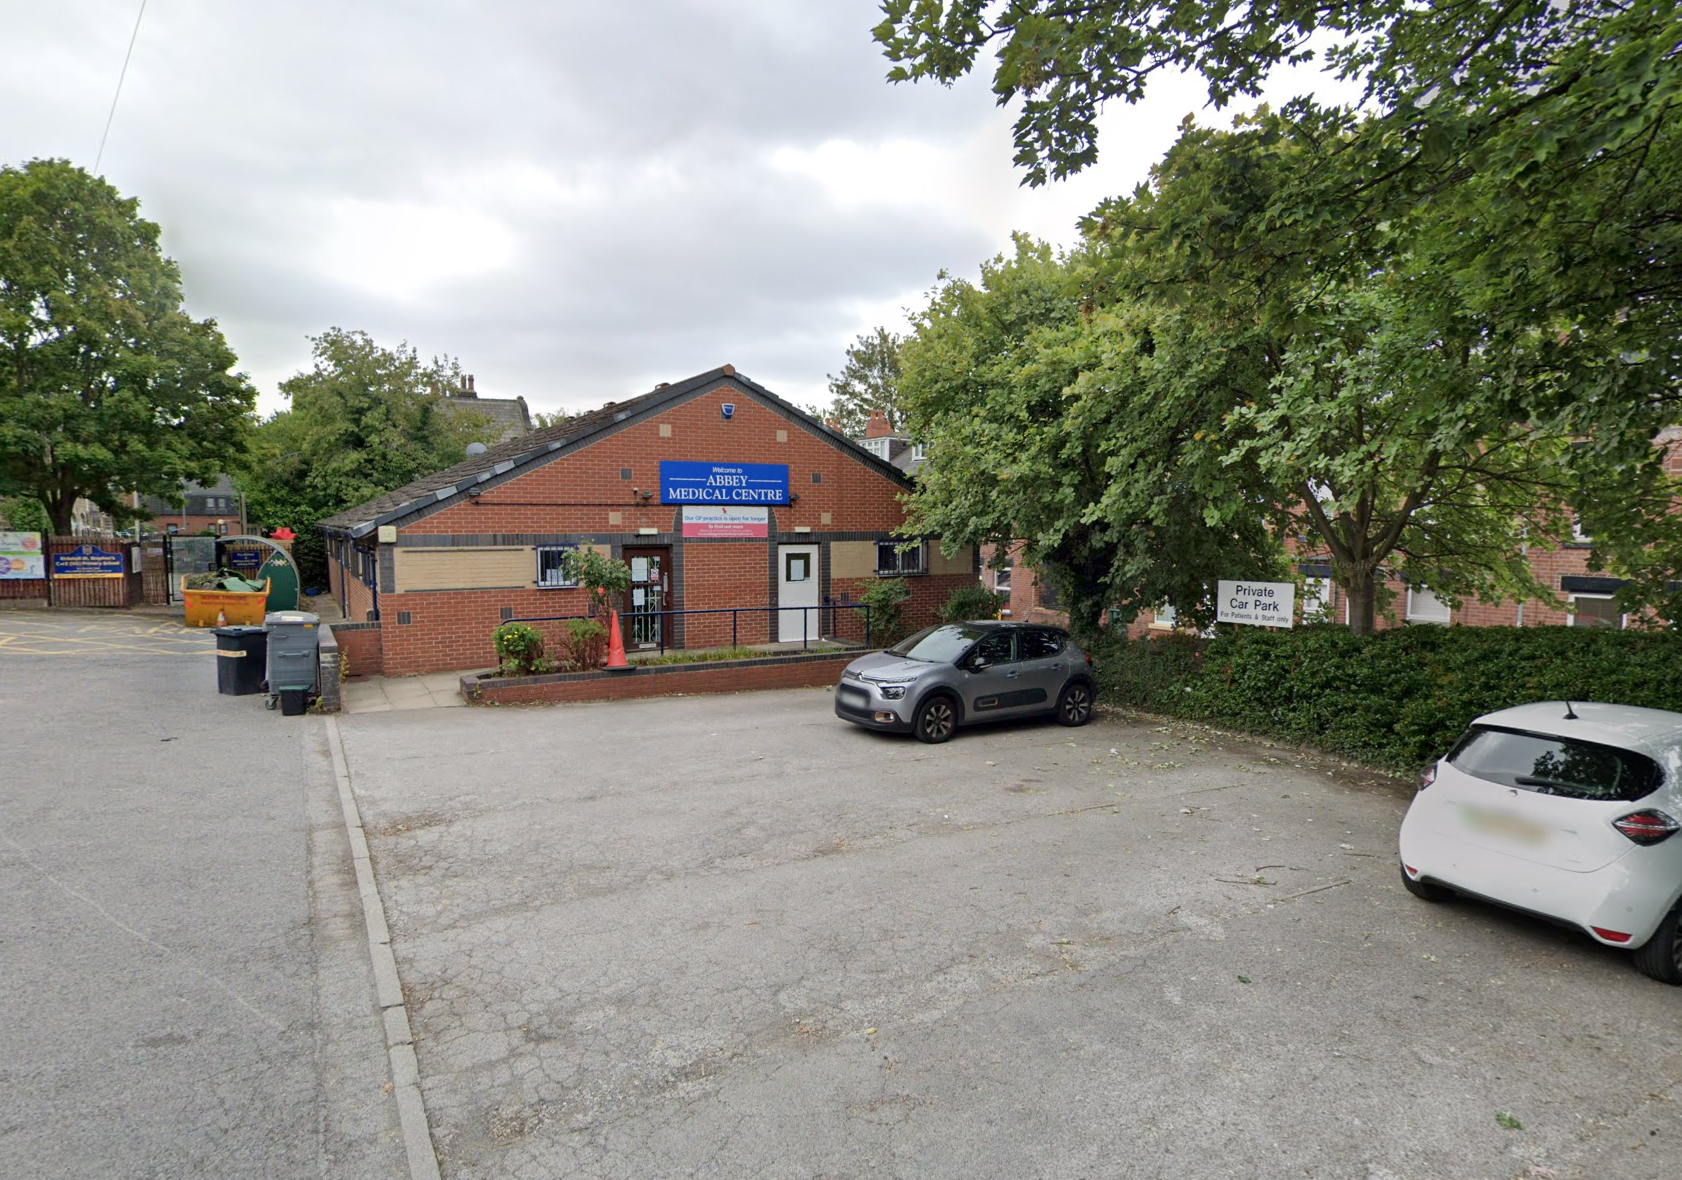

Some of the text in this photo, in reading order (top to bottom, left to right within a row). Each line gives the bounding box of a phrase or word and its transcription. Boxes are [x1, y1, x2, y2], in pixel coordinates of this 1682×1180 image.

[712, 466, 736, 474] Welcome
[706, 475, 748, 487] ABBEY
[668, 488, 783, 500] MEDICAL CENTRE
[1236, 585, 1274, 598] Private
[1230, 598, 1279, 612] Car Park
[1231, 612, 1252, 620] Patients
[1277, 615, 1289, 623] only
